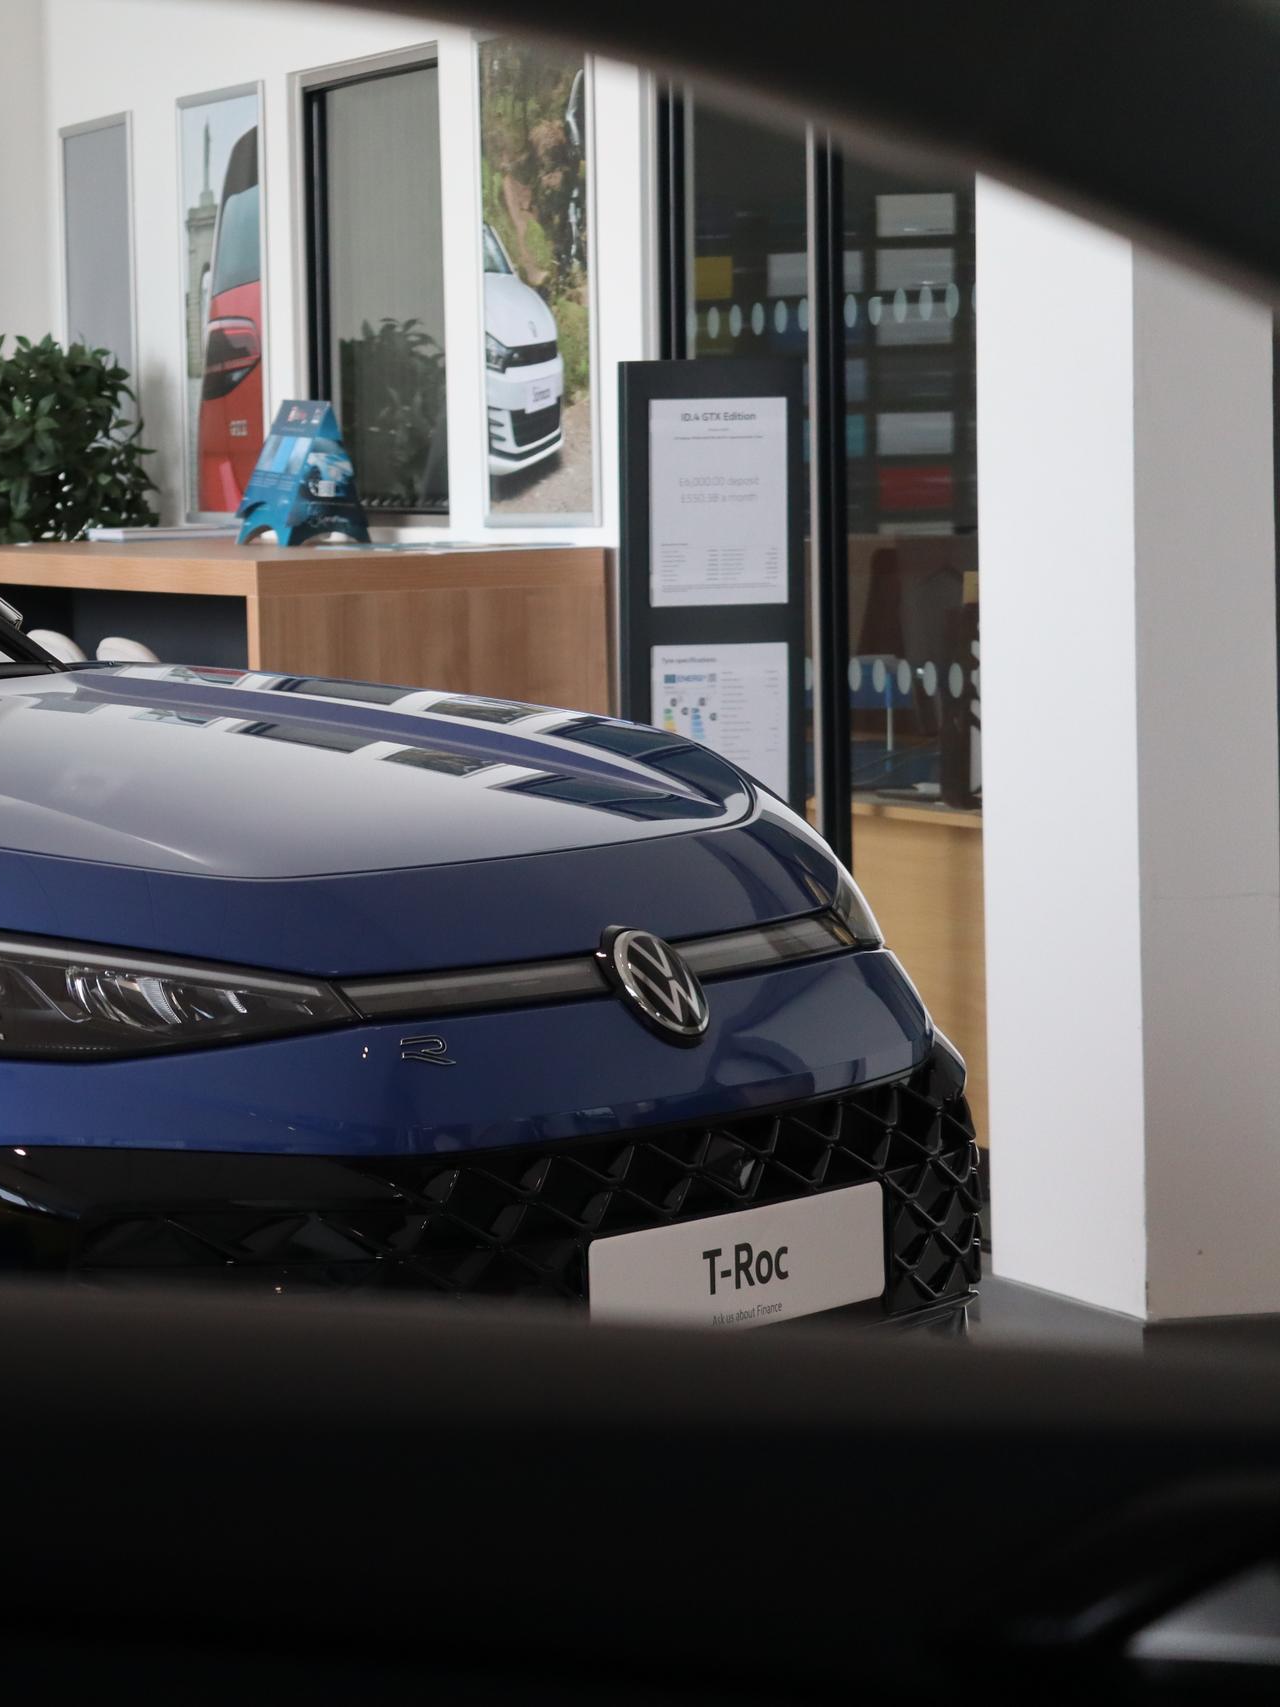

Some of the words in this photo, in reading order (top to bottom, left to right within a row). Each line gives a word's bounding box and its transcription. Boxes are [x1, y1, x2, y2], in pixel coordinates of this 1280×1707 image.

[681, 412, 700, 422] ID.4
[702, 412, 721, 422] GTX
[723, 411, 756, 421] Edition
[727, 475, 759, 488] deposit
[400, 1034, 457, 1066] R
[702, 1242, 789, 1295] T-Roc
[726, 1313, 734, 1324] us
[735, 1307, 756, 1323] about
[756, 1301, 783, 1318] Finance
